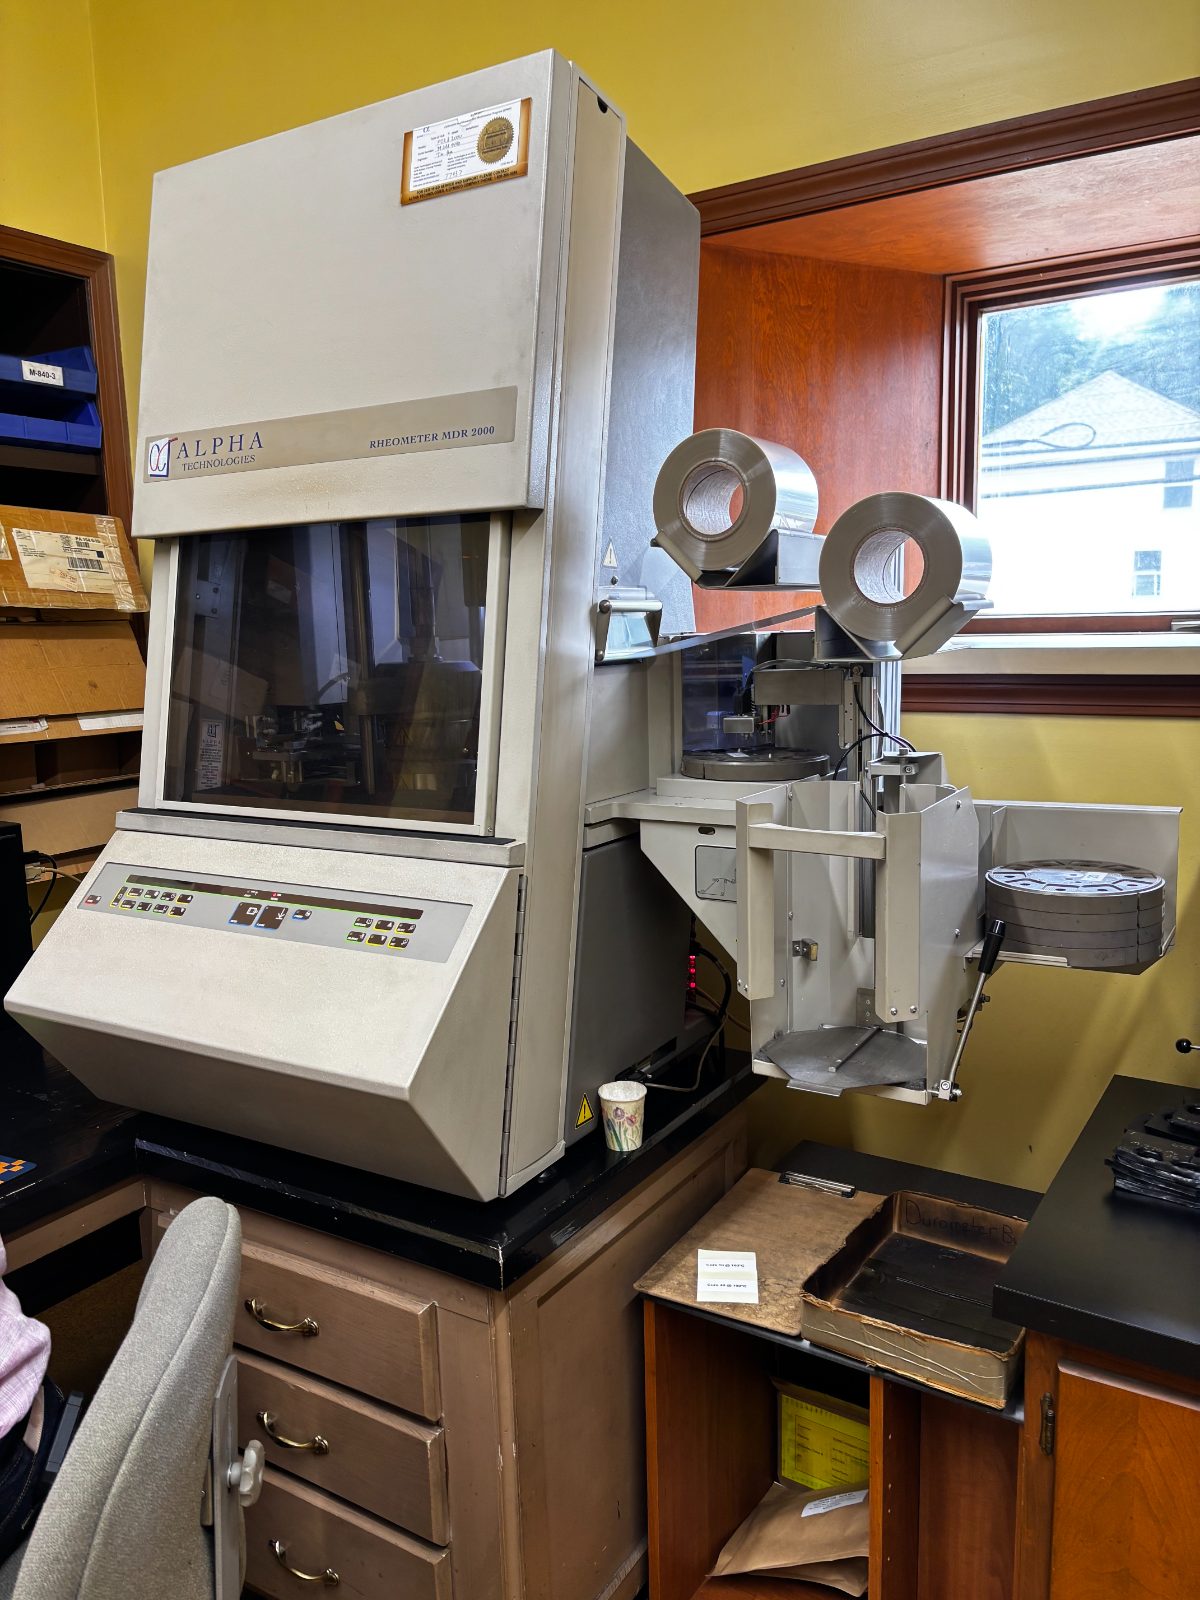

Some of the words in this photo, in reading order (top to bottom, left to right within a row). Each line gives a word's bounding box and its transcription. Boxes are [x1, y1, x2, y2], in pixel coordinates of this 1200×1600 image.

[29, 368, 56, 380] M-840-3
[176, 431, 264, 460] ALPHA
[369, 433, 439, 449] RHEOMETER
[441, 429, 468, 441] MDR
[471, 425, 495, 437] 2000
[182, 454, 256, 471] TECHNOLOGIES
